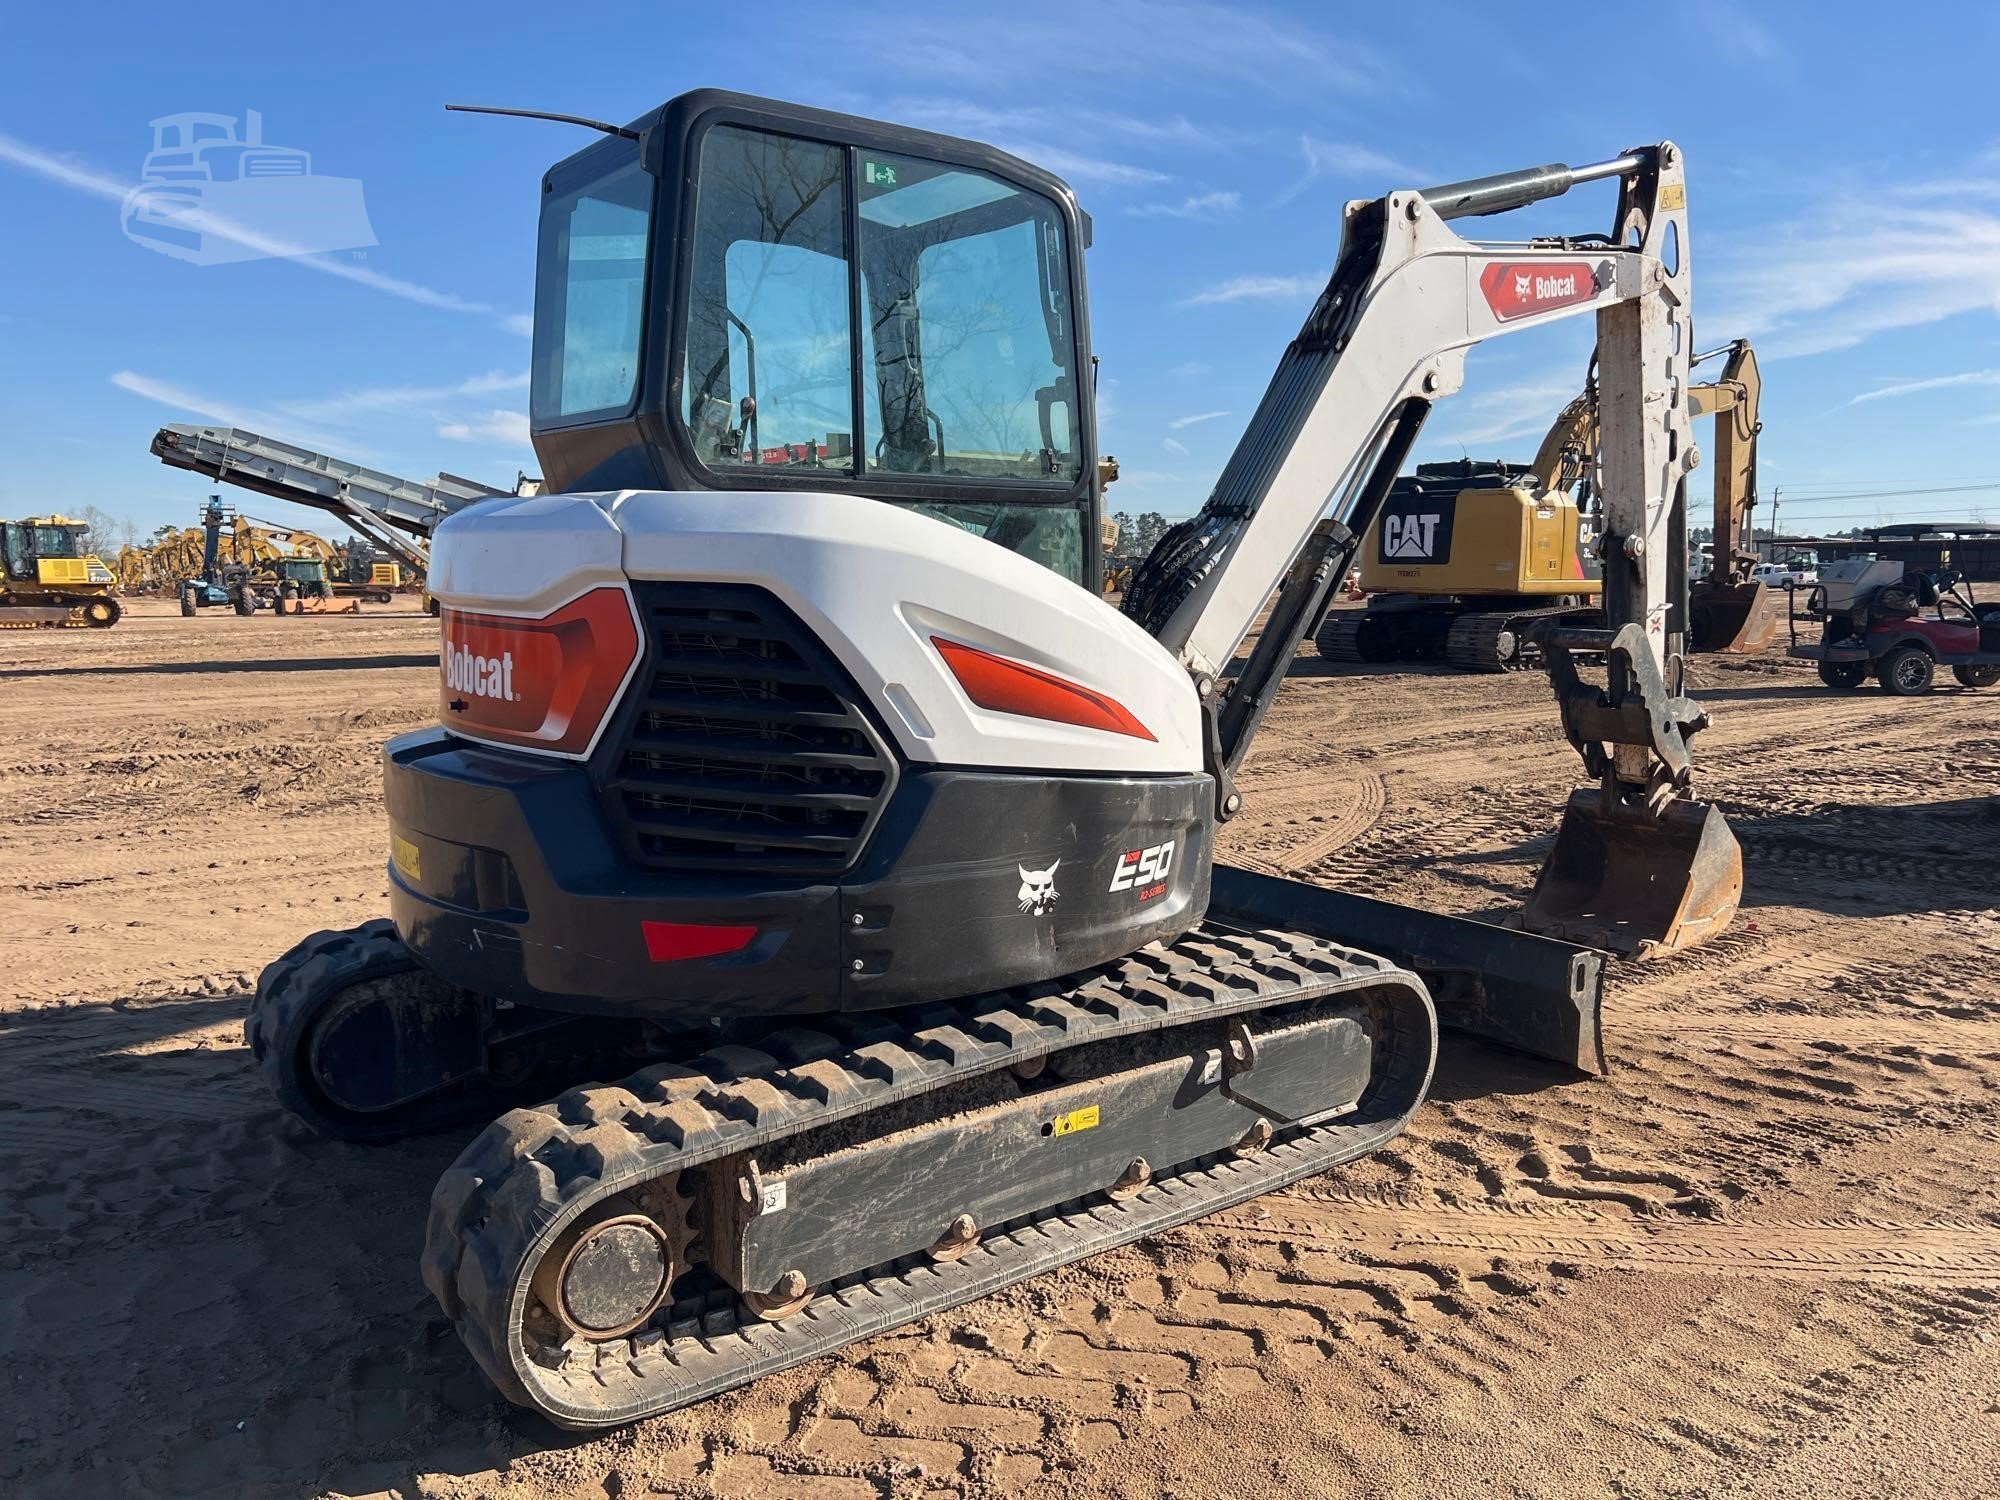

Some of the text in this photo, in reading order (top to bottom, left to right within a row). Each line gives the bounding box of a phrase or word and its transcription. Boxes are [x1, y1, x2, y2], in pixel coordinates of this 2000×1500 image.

[1535, 274, 1575, 299] Bobcat
[1384, 514, 1440, 557] CAT
[446, 640, 513, 701] Bobcat
[1108, 840, 1175, 893] E50
